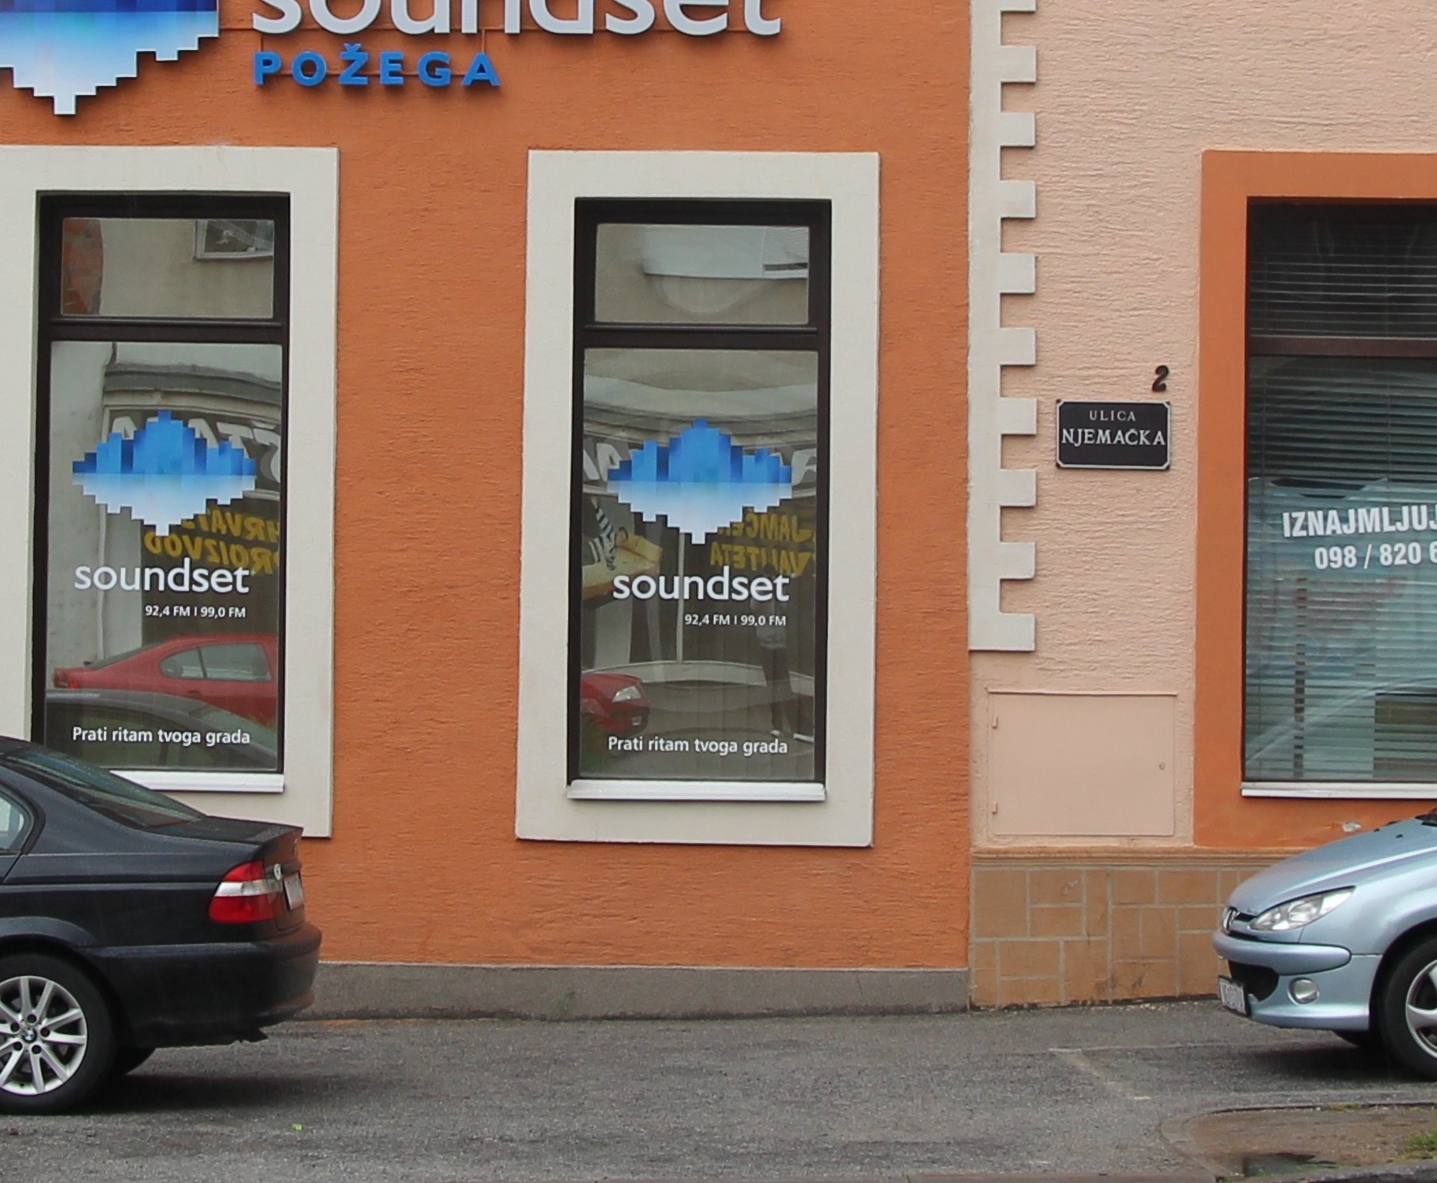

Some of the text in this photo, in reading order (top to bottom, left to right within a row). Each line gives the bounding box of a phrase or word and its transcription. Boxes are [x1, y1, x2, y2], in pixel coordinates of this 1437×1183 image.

[253, 43, 501, 88] POŽEGA
[1151, 364, 1170, 393] 2
[1089, 410, 1137, 422] ULICA
[1061, 427, 1166, 447] NJEMAČKA
[1314, 546, 1358, 569] 098
[1379, 541, 1422, 566] 820
[74, 557, 250, 593] soundset
[613, 565, 790, 602] soundset
[145, 604, 170, 618] 92,4
[173, 605, 190, 616] FM
[200, 606, 226, 619] 99,0
[228, 606, 247, 618] FM
[684, 613, 710, 626] 92,4
[713, 614, 730, 625] FM
[769, 615, 787, 626] FM
[72, 726, 251, 747] Prati ritam tvoga grada
[608, 735, 789, 757] Prati ritam tvoga grada
